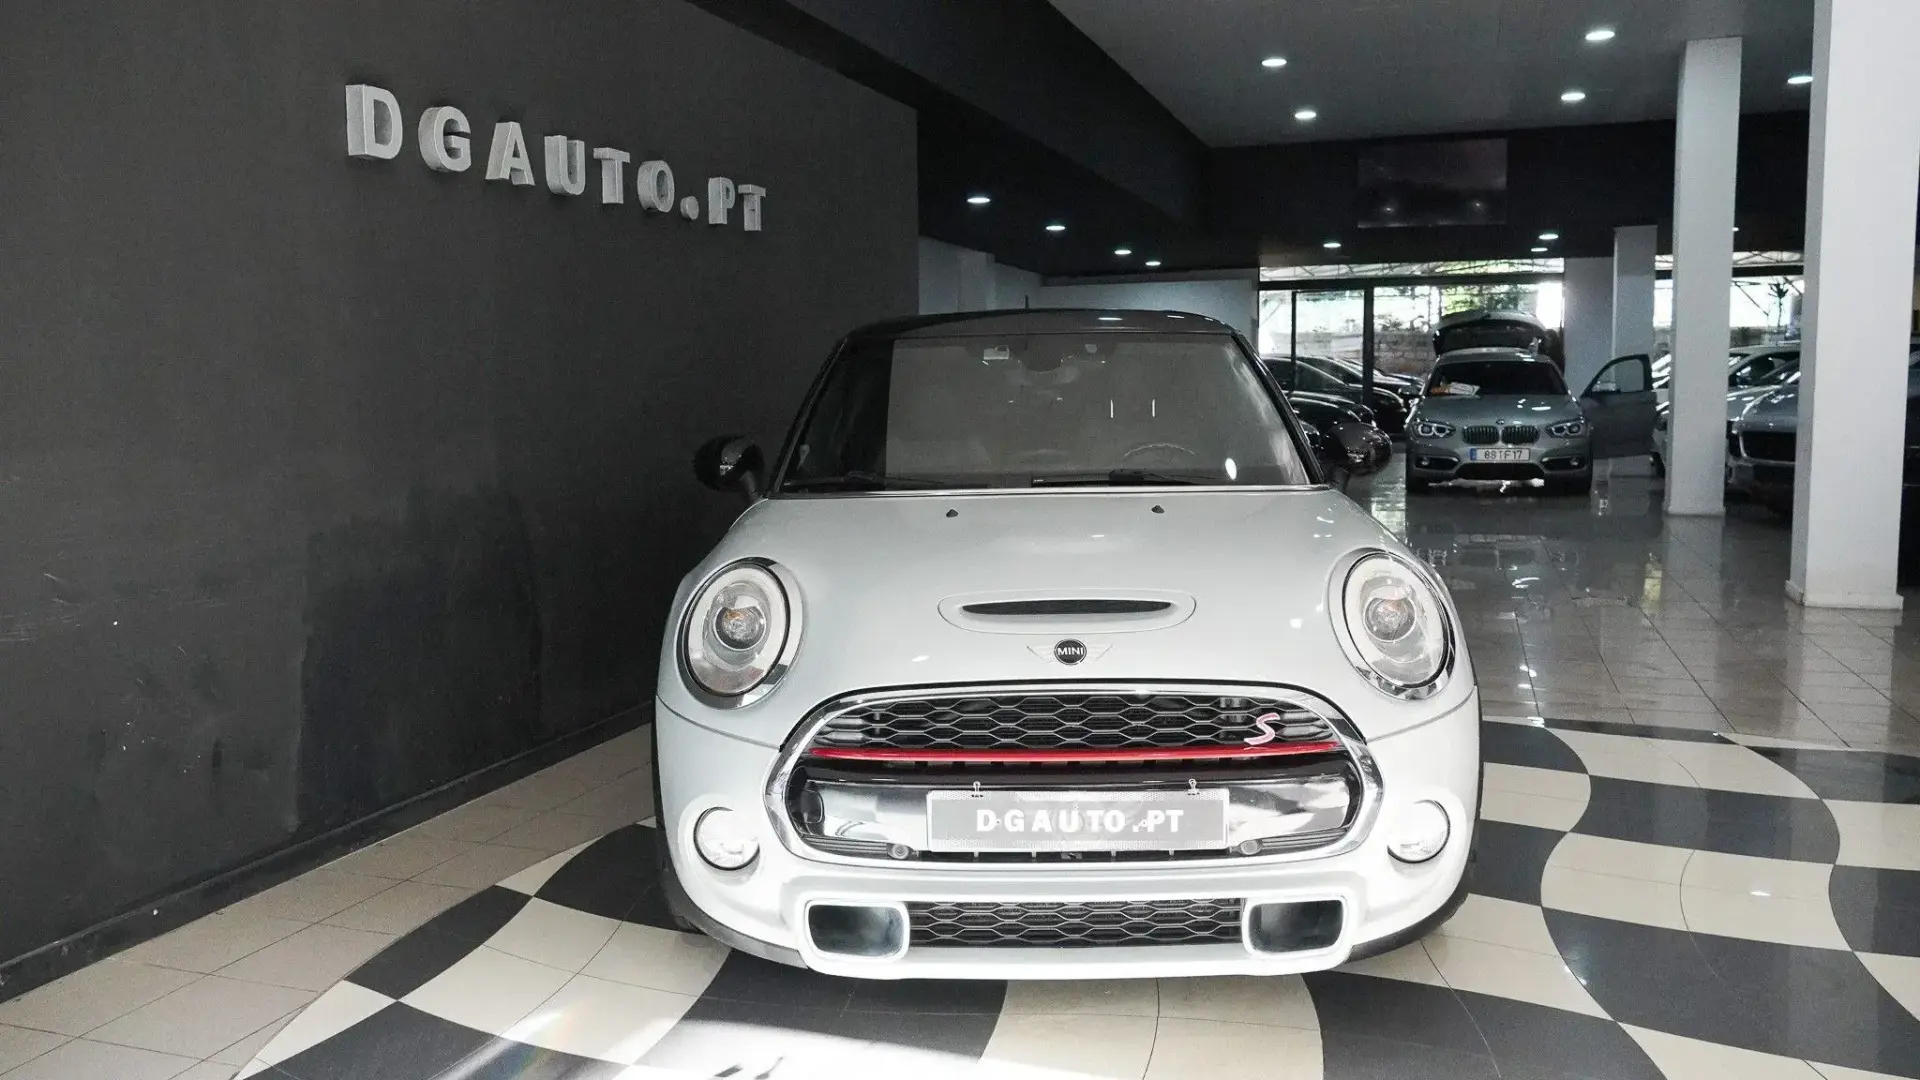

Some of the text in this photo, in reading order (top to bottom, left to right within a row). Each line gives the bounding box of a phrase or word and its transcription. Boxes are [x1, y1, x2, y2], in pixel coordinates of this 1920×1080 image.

[345, 83, 767, 232] DGAUTO.PT
[1057, 646, 1084, 656] MINI
[1243, 712, 1281, 746] S
[976, 808, 1185, 833] DGAUTO.PT
